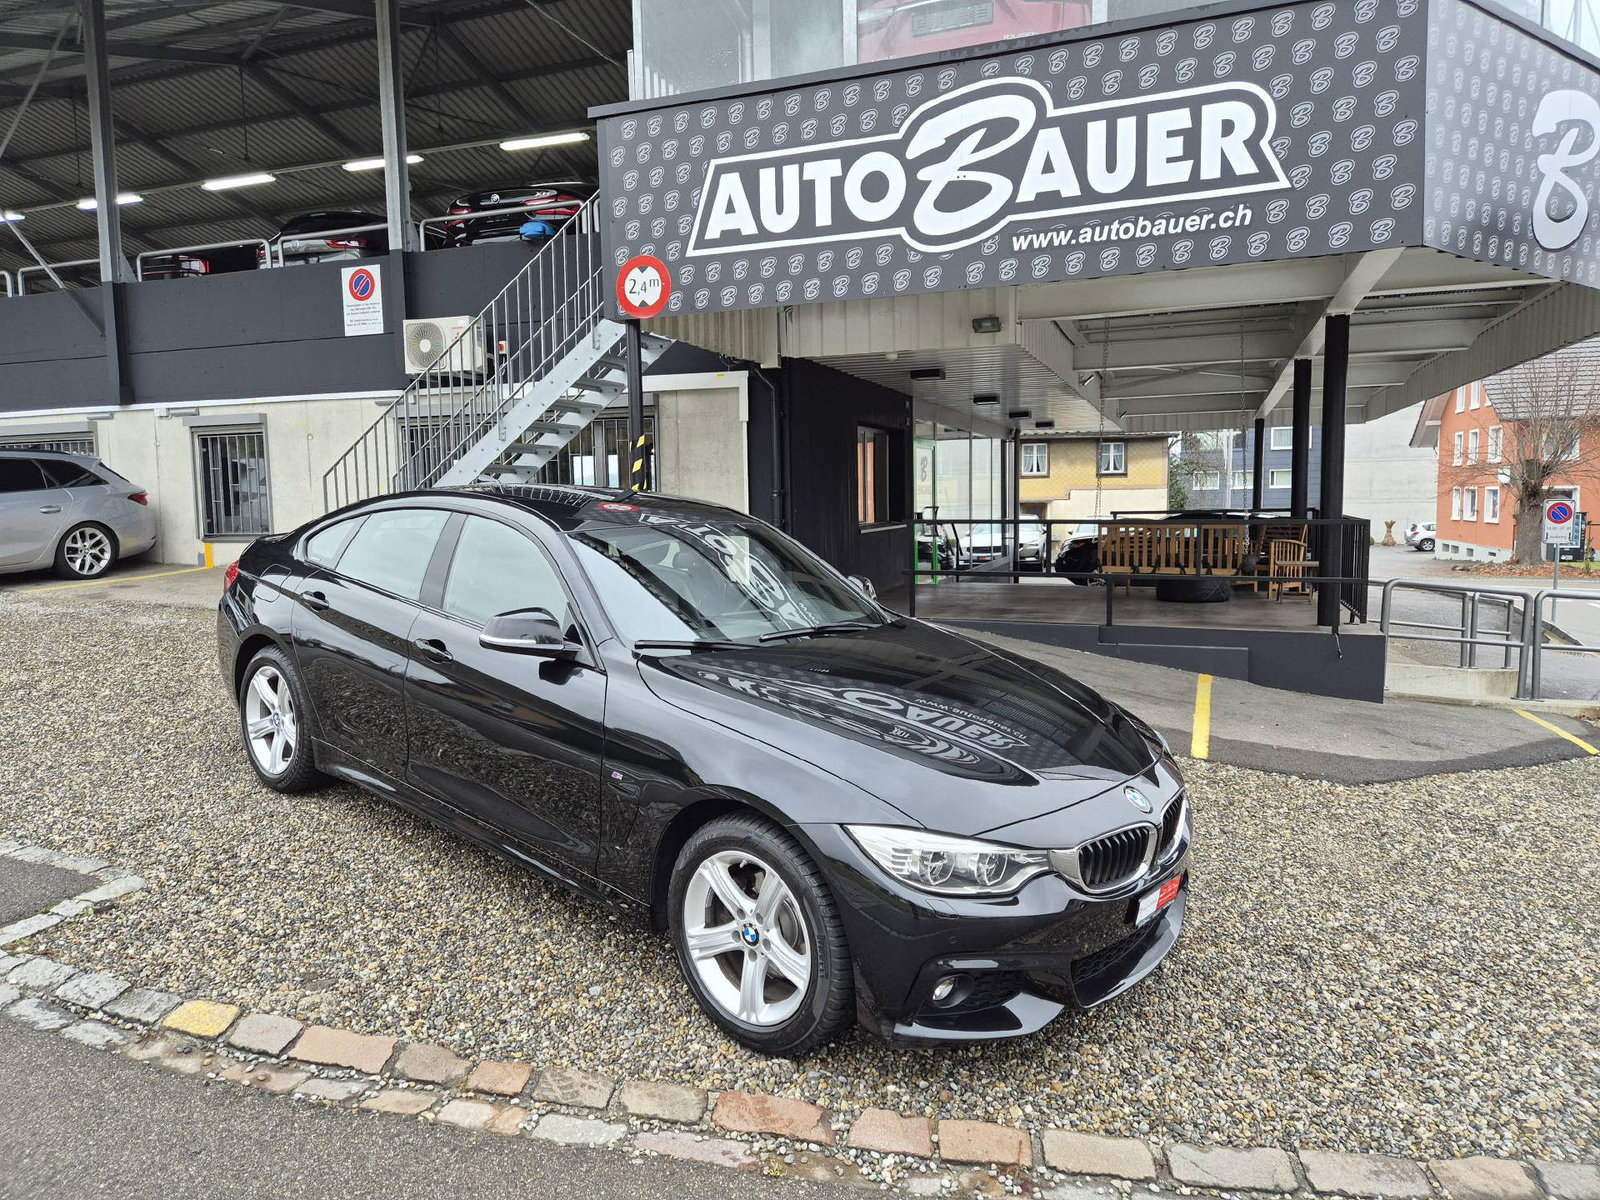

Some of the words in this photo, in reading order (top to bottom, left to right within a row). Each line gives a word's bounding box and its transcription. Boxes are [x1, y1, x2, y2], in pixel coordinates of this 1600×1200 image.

[704, 151, 907, 240] AUTO
[905, 94, 1259, 236] BAUER
[1012, 203, 1252, 251] www.autobauer.ch
